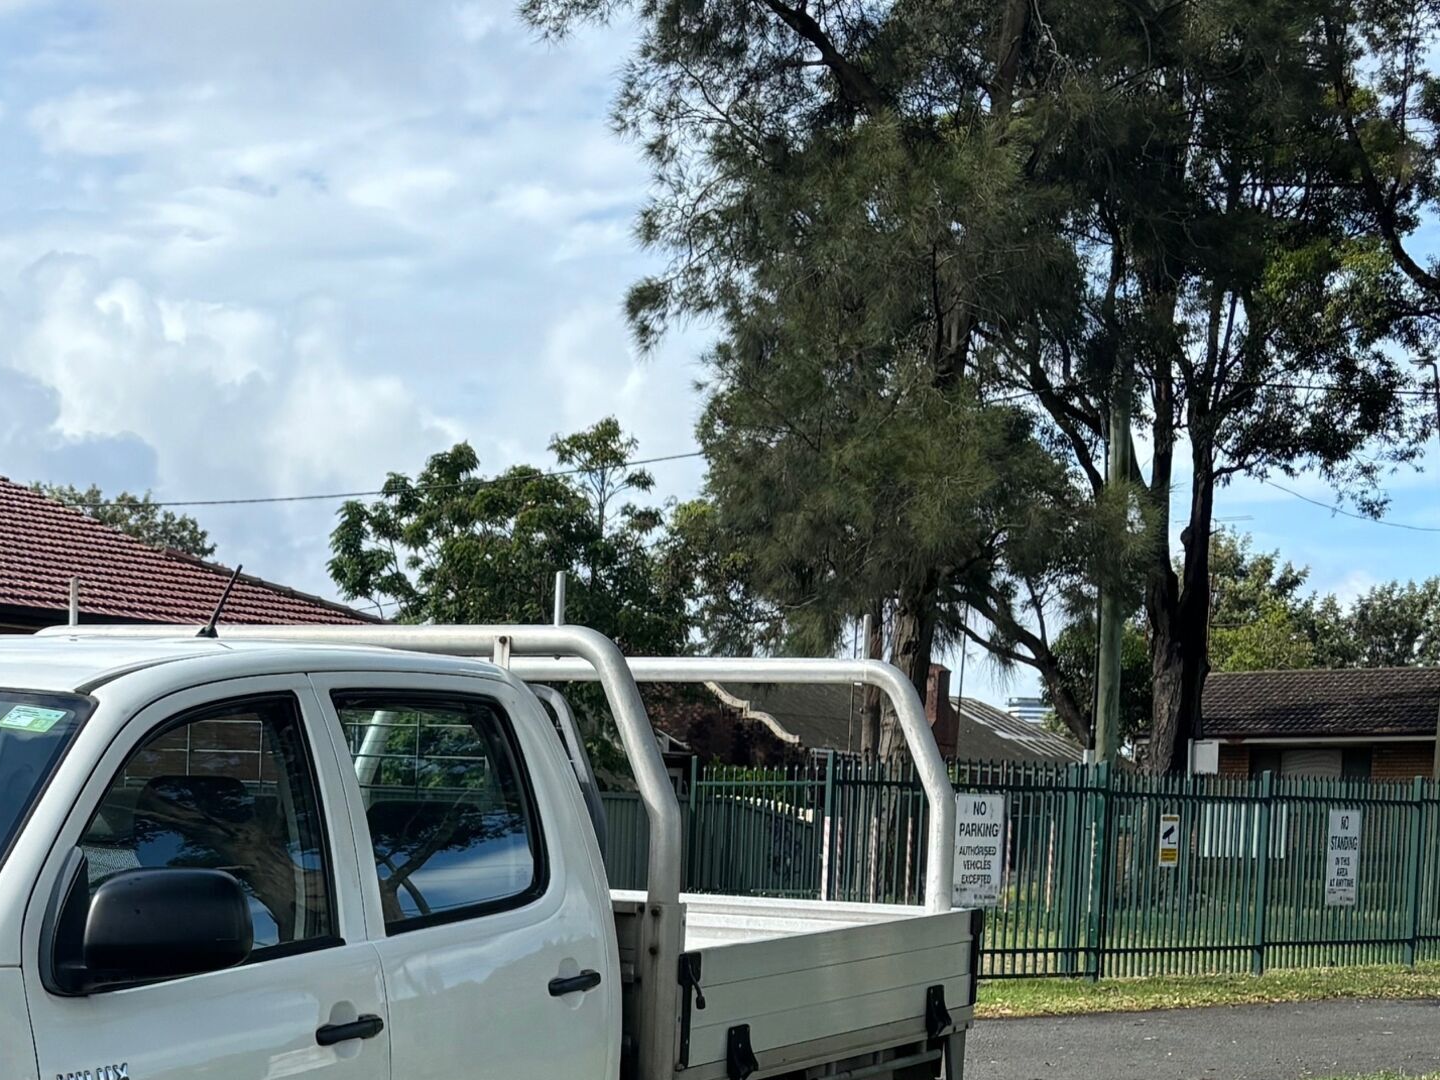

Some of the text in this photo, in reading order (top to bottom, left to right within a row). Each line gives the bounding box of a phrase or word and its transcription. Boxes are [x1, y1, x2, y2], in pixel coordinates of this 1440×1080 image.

[973, 801, 987, 816] NO
[959, 822, 1000, 837] PARKING
[1340, 815, 1349, 830] NO
[959, 845, 997, 856] AUTHORISED
[1330, 836, 1358, 851] STANDING
[963, 860, 991, 870] VEHICLES
[961, 874, 992, 885] EXCEPTED
